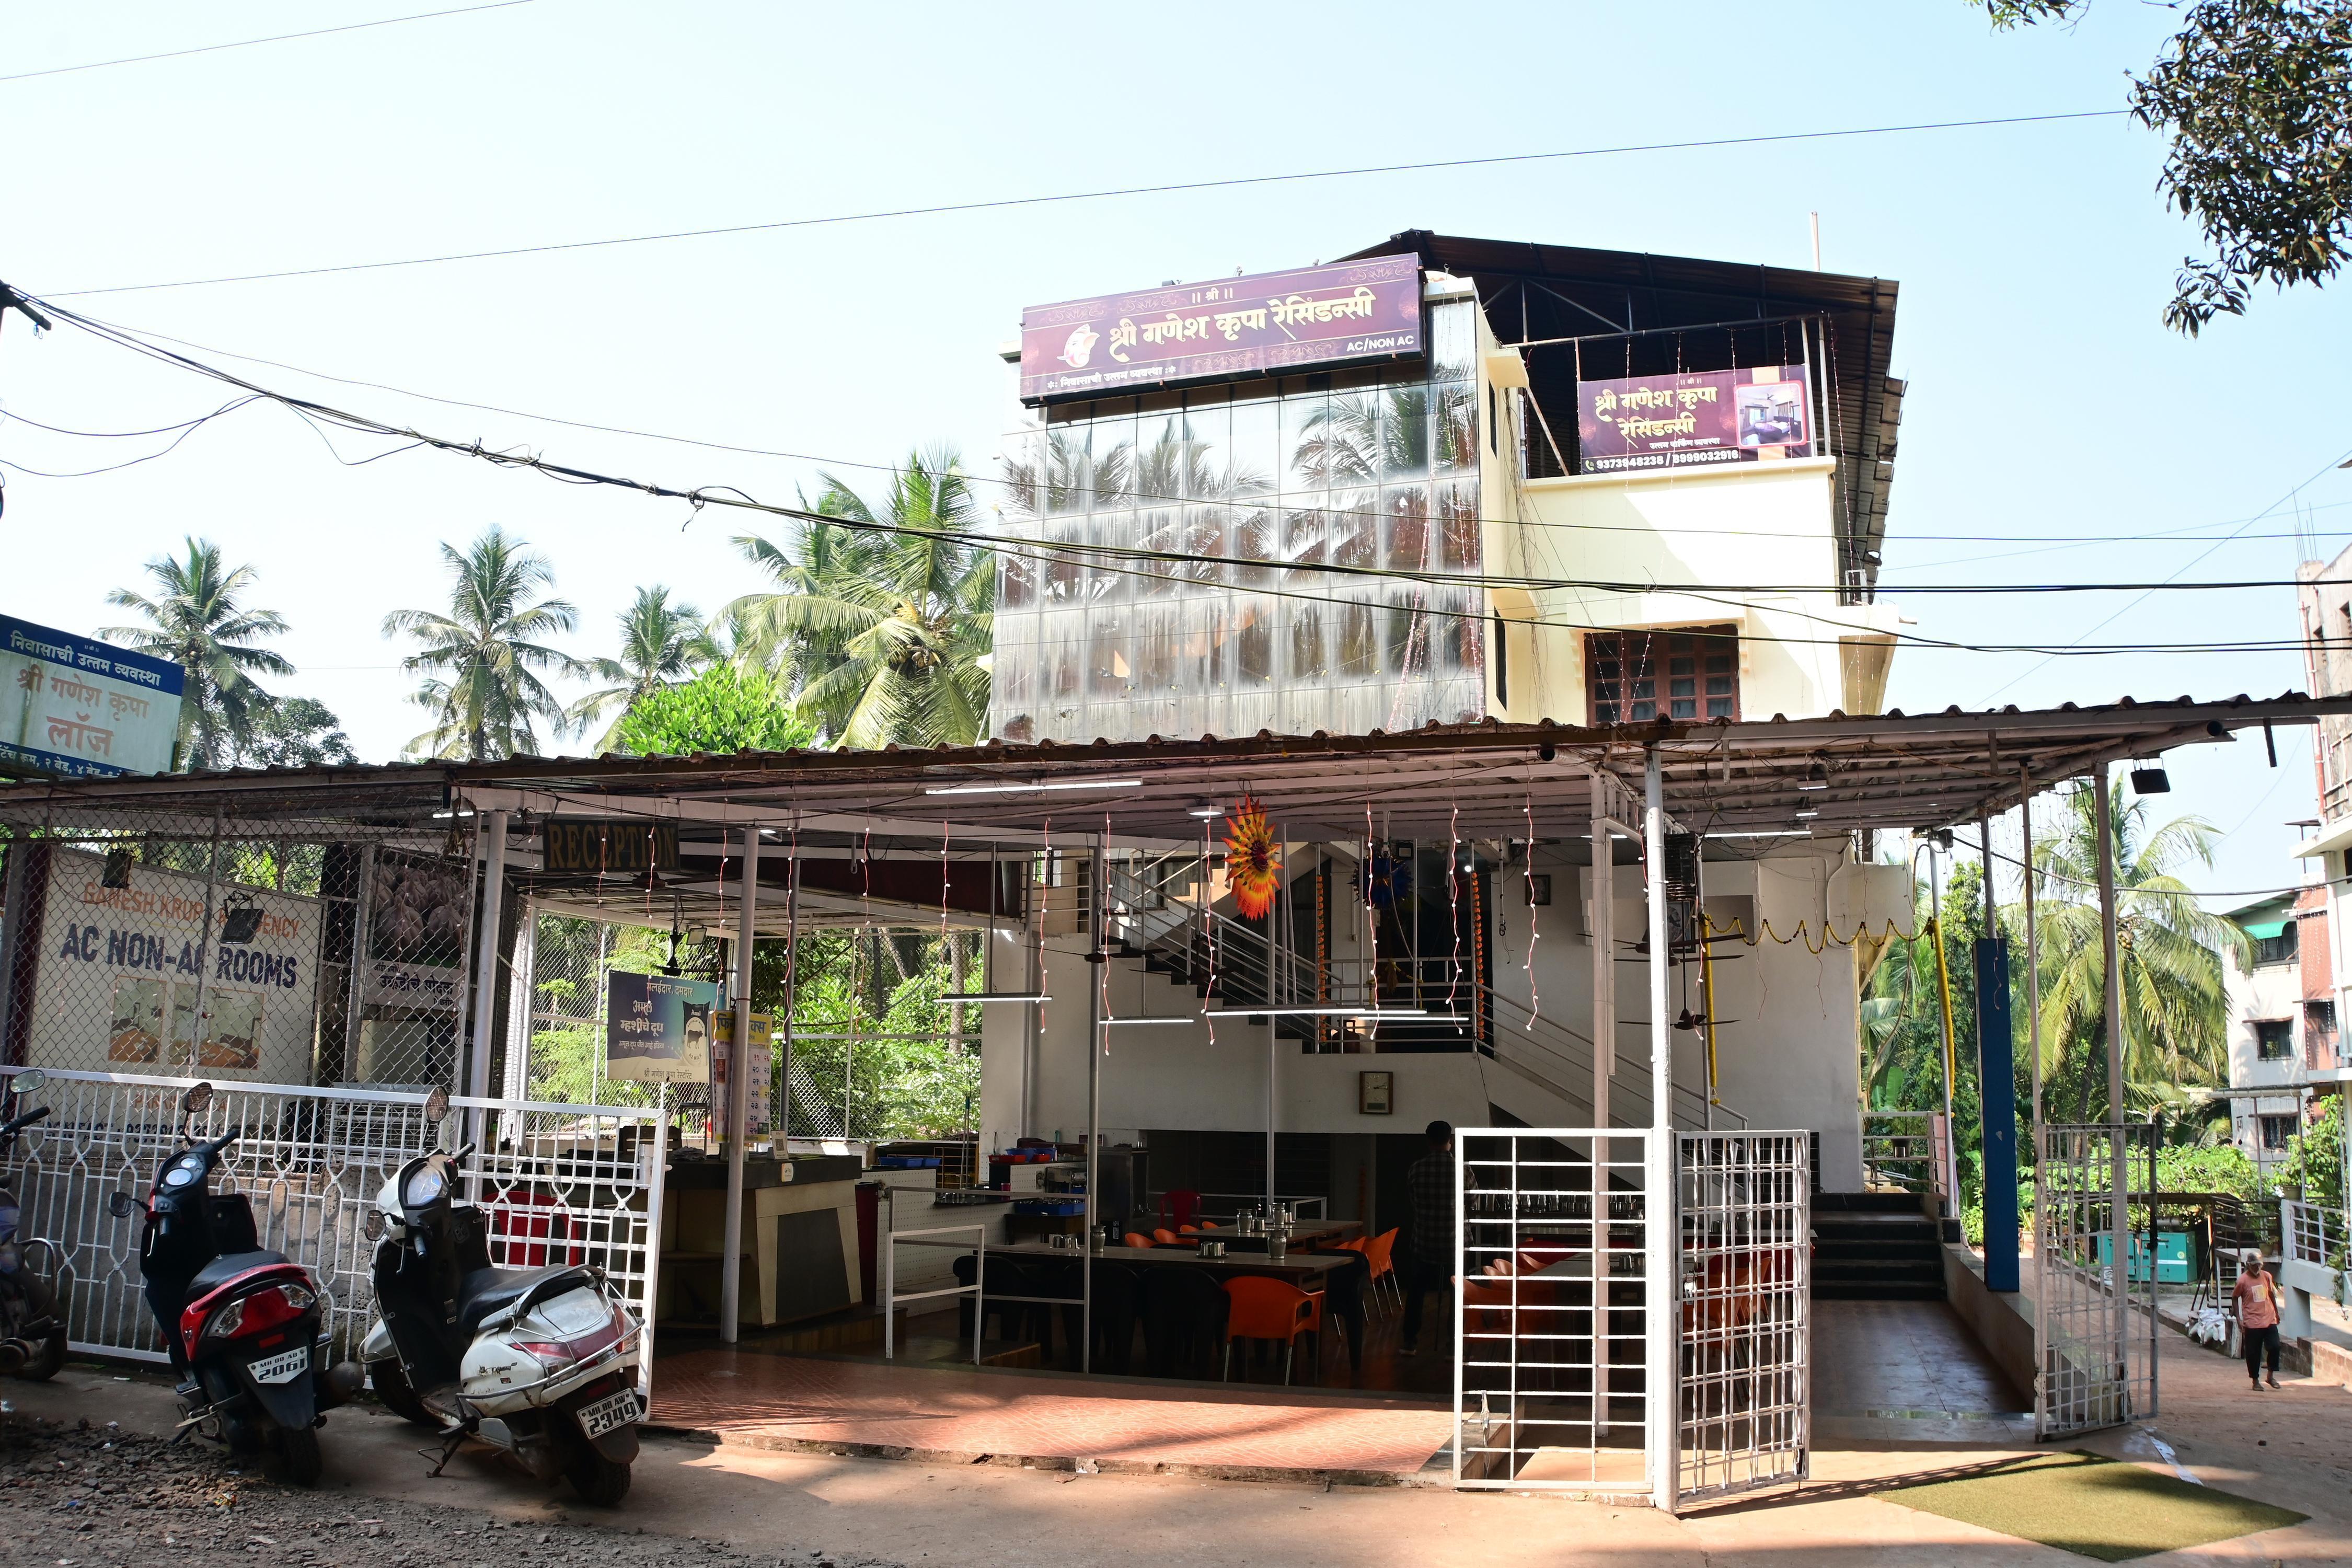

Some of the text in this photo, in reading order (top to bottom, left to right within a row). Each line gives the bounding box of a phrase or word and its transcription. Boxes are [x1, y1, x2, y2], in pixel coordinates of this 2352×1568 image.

[1205, 287, 1219, 301] श्री
[1110, 286, 1377, 362] श्री गणेश कृपा रेसिडन्सी
[1346, 335, 1414, 353] AC/NON AC
[1060, 366, 1163, 387] निवासाची उत्तम व्यवस्था
[1595, 386, 1718, 422] श्री गणेश कृपा
[1616, 411, 1697, 448] रेसिडन्सी
[1596, 455, 1664, 469] 9373948238
[1673, 449, 1739, 464] 8999032916
[10, 630, 162, 687] निवासाची उत्तम व्यवस्था
[17, 664, 151, 722] श्री गणेश कृपा
[46, 711, 114, 757] लॉज
[45, 758, 51, 769] २
[54, 756, 72, 774] बेड,
[76, 765, 84, 775] ४
[548, 824, 676, 869] RECEPTION
[84, 881, 301, 940] GANESH KRUP RENCY
[60, 923, 100, 963] AC
[215, 946, 297, 988] ROOMS
[675, 985, 694, 997] दमदार
[620, 1017, 664, 1036] म्हशीचे दूध
[651, 1068, 664, 1078] गणेश
[258, 1358, 305, 1381] 2061
[588, 1406, 601, 1417] MH
[614, 1395, 626, 1406] AW
[588, 1401, 637, 1435] 2349
